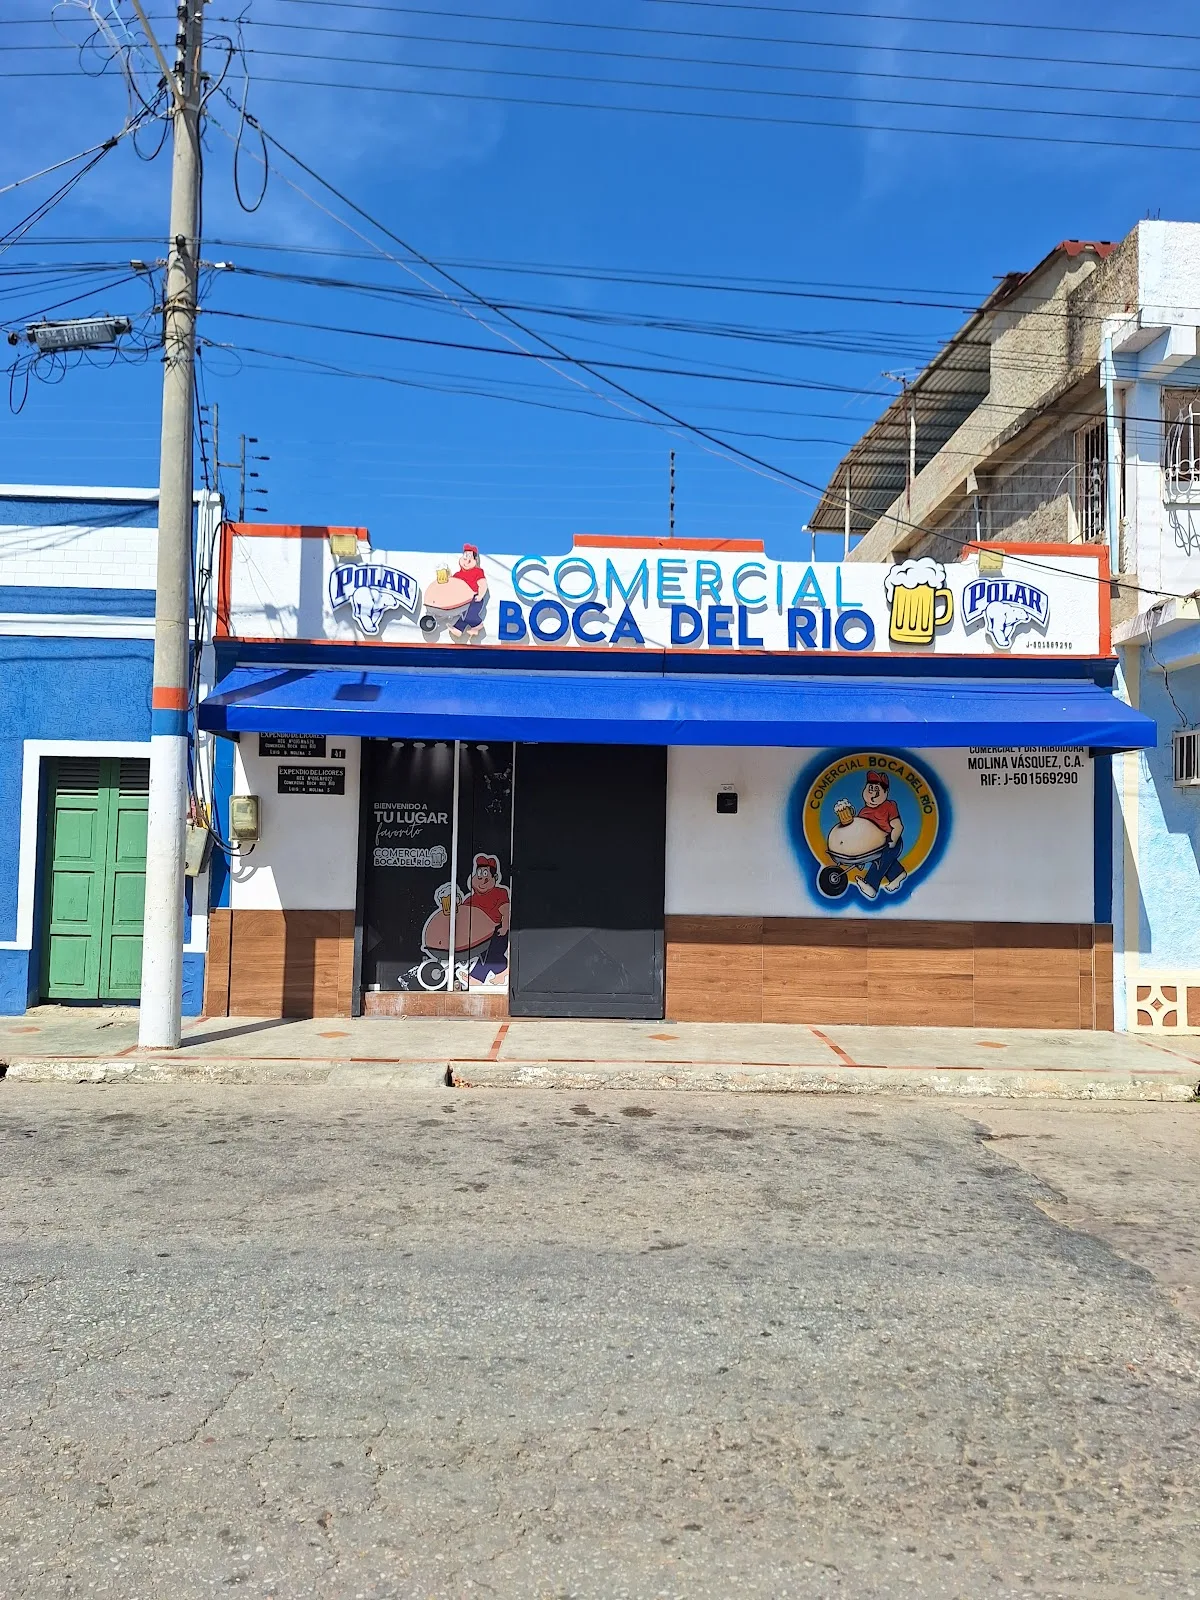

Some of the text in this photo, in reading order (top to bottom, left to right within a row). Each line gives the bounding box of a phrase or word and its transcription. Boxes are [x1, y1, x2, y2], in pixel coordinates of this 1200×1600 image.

[335, 567, 411, 600] POLAR
[511, 554, 863, 607] COMERCIAL
[968, 582, 1042, 614] POLAR
[498, 599, 875, 650] BOCA DEL RIO
[968, 754, 1085, 769] MOLINA VÁSQUEZ, C.A.
[810, 759, 864, 810] COMERCIAL
[868, 757, 905, 776] BOCA
[906, 772, 923, 794] DEL
[980, 772, 1078, 786] RIF: J-501569290
[374, 811, 448, 824] TU LUGAR
[375, 822, 423, 846] favorito
[374, 849, 430, 858] COMERCIAL
[374, 859, 399, 867] BOCA
